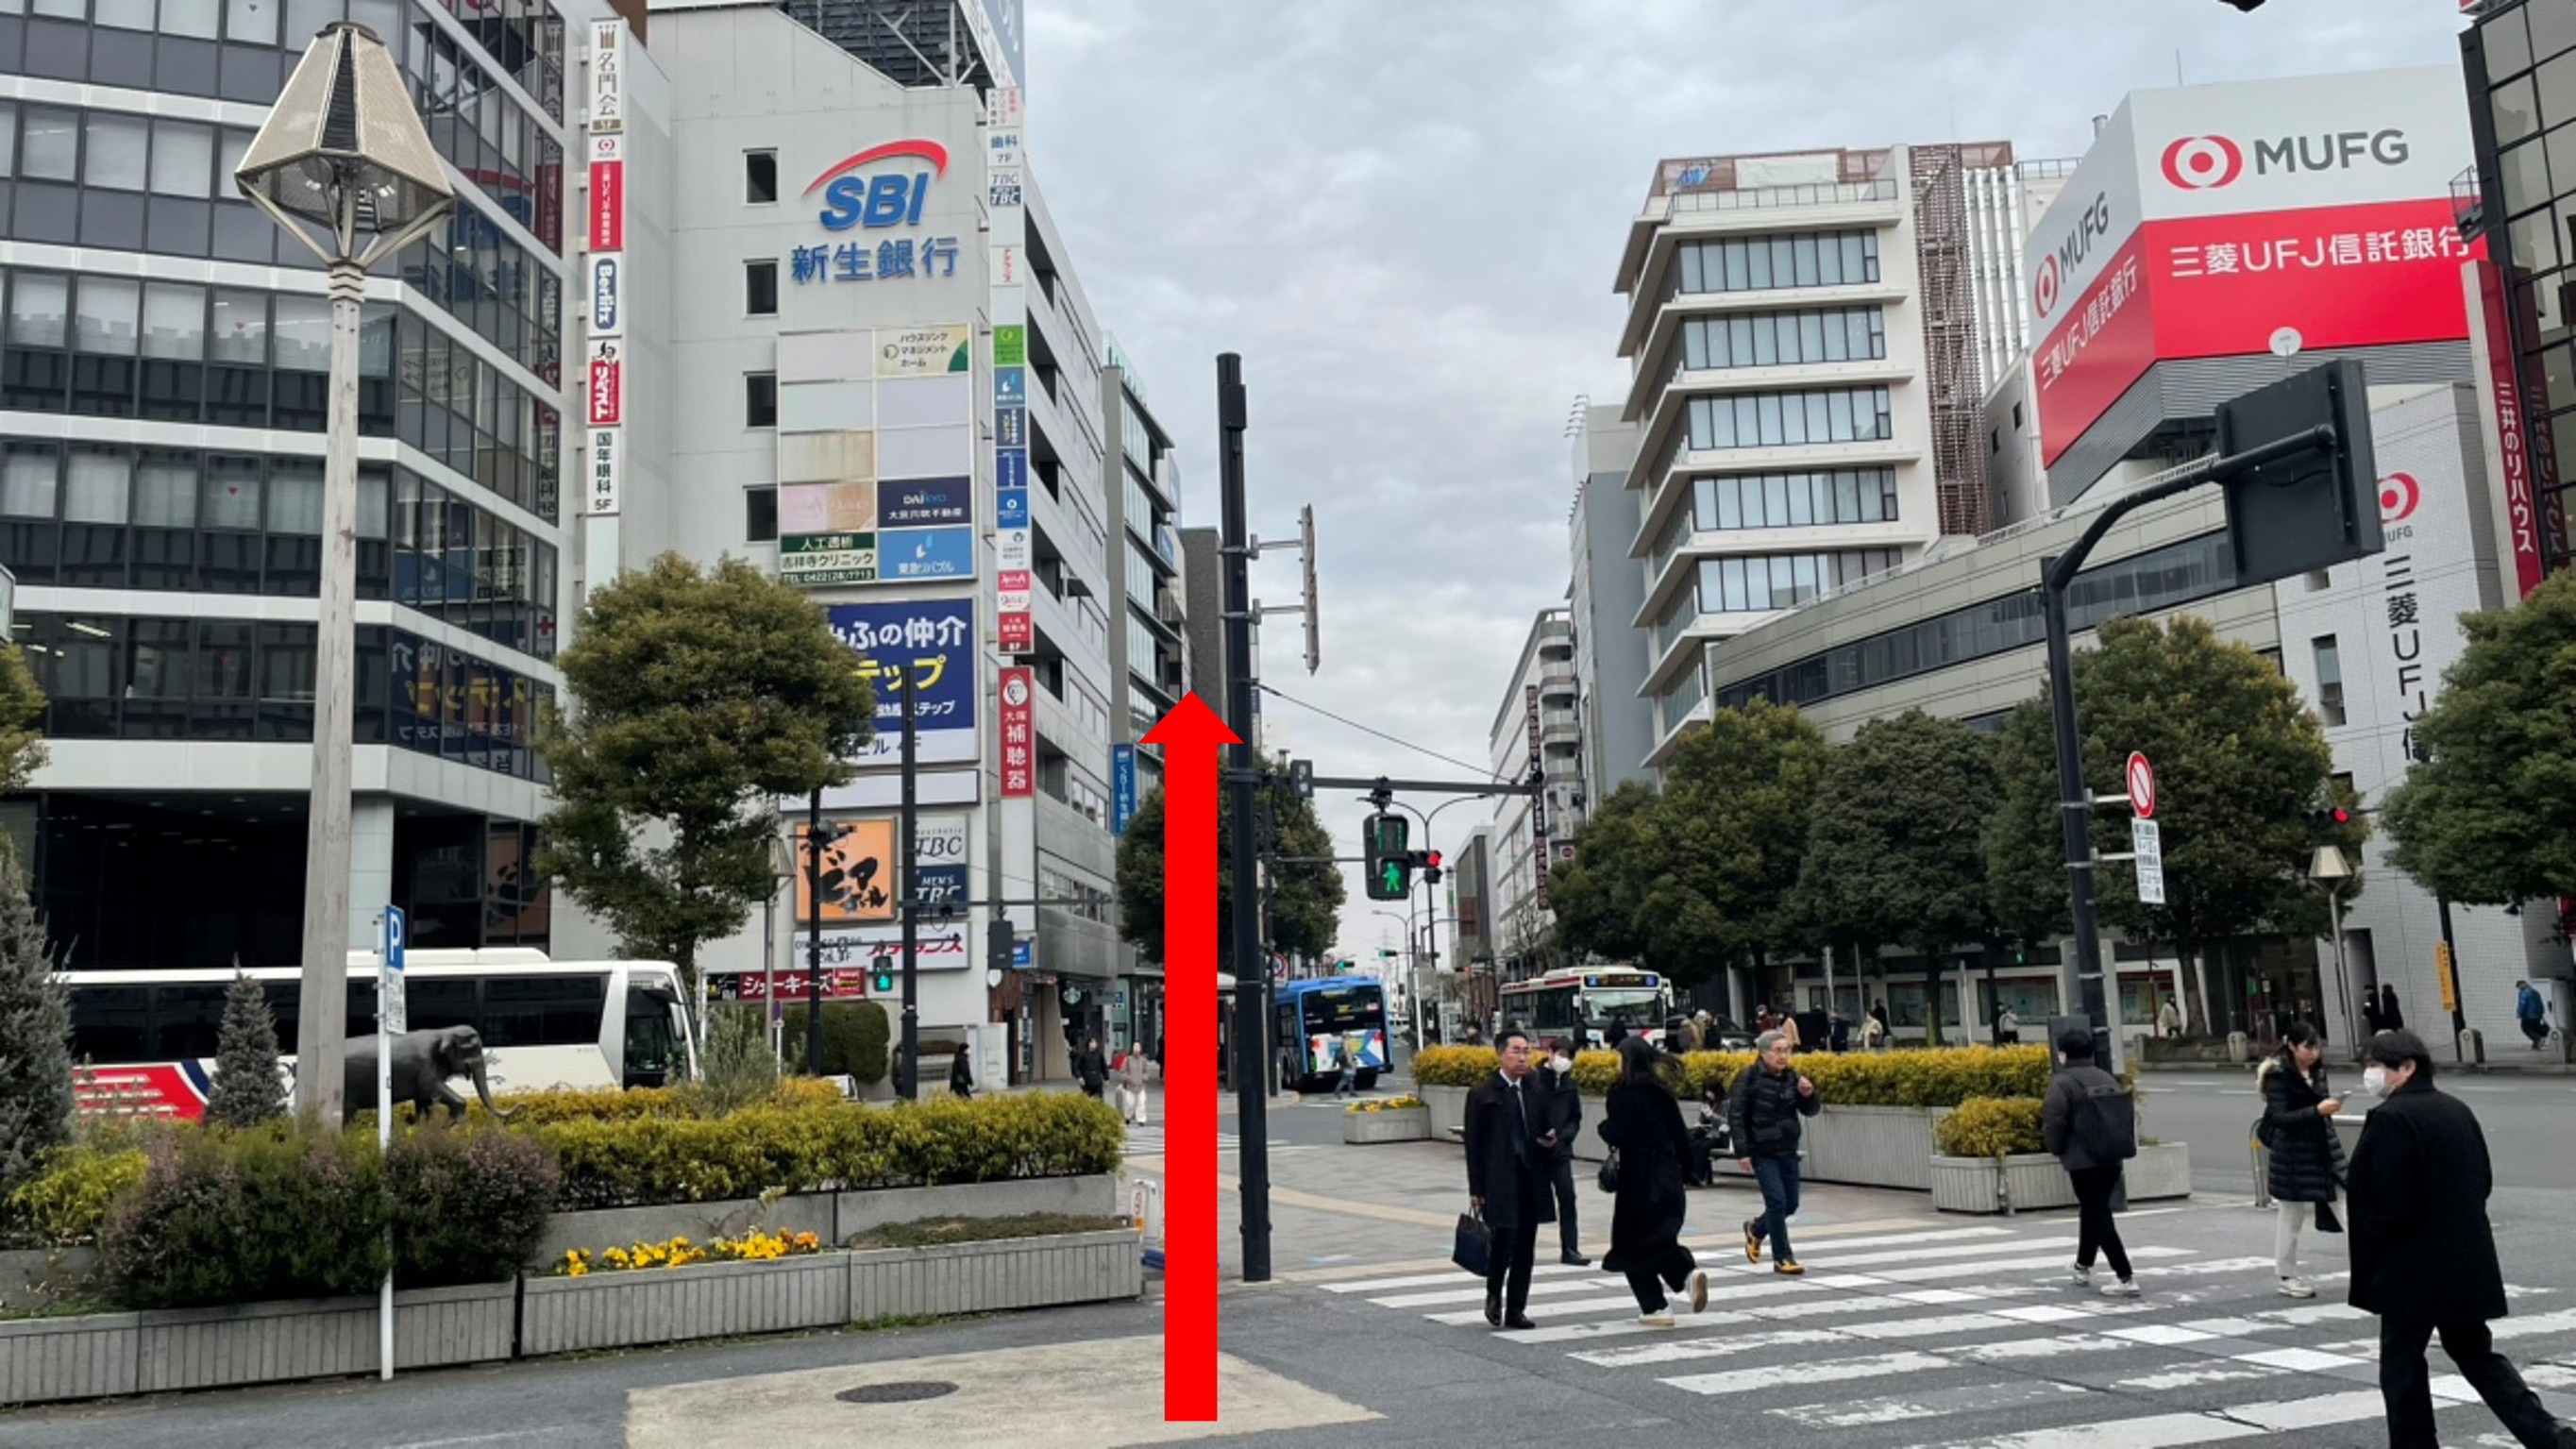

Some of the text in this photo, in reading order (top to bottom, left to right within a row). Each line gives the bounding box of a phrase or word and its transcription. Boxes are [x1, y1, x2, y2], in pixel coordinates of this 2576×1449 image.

[597, 53, 616, 115] 名門会
[2255, 129, 2410, 176] MUFG
[819, 173, 930, 230] SBI
[991, 173, 1019, 184] TBC
[791, 237, 959, 284] 新生銀行
[2060, 193, 2110, 283] MUFG
[2171, 227, 2470, 278] 三菱UFJ信託銀行
[598, 265, 614, 324] Berlitz
[2041, 256, 2138, 391] 三菱UFJ信託銀行
[901, 344, 948, 355] マネジメント
[596, 432, 613, 494] 国年眼科
[2498, 381, 2534, 553] 三井のリハウス
[595, 499, 613, 510] 5F
[800, 536, 853, 551] 人工透析
[2386, 525, 2414, 543] UFG
[782, 552, 874, 568] 吉祥寺クリニック
[783, 573, 802, 582] TEL
[1006, 724, 1027, 790] 補聴器
[915, 835, 963, 857] TBC
[390, 912, 401, 961] P
